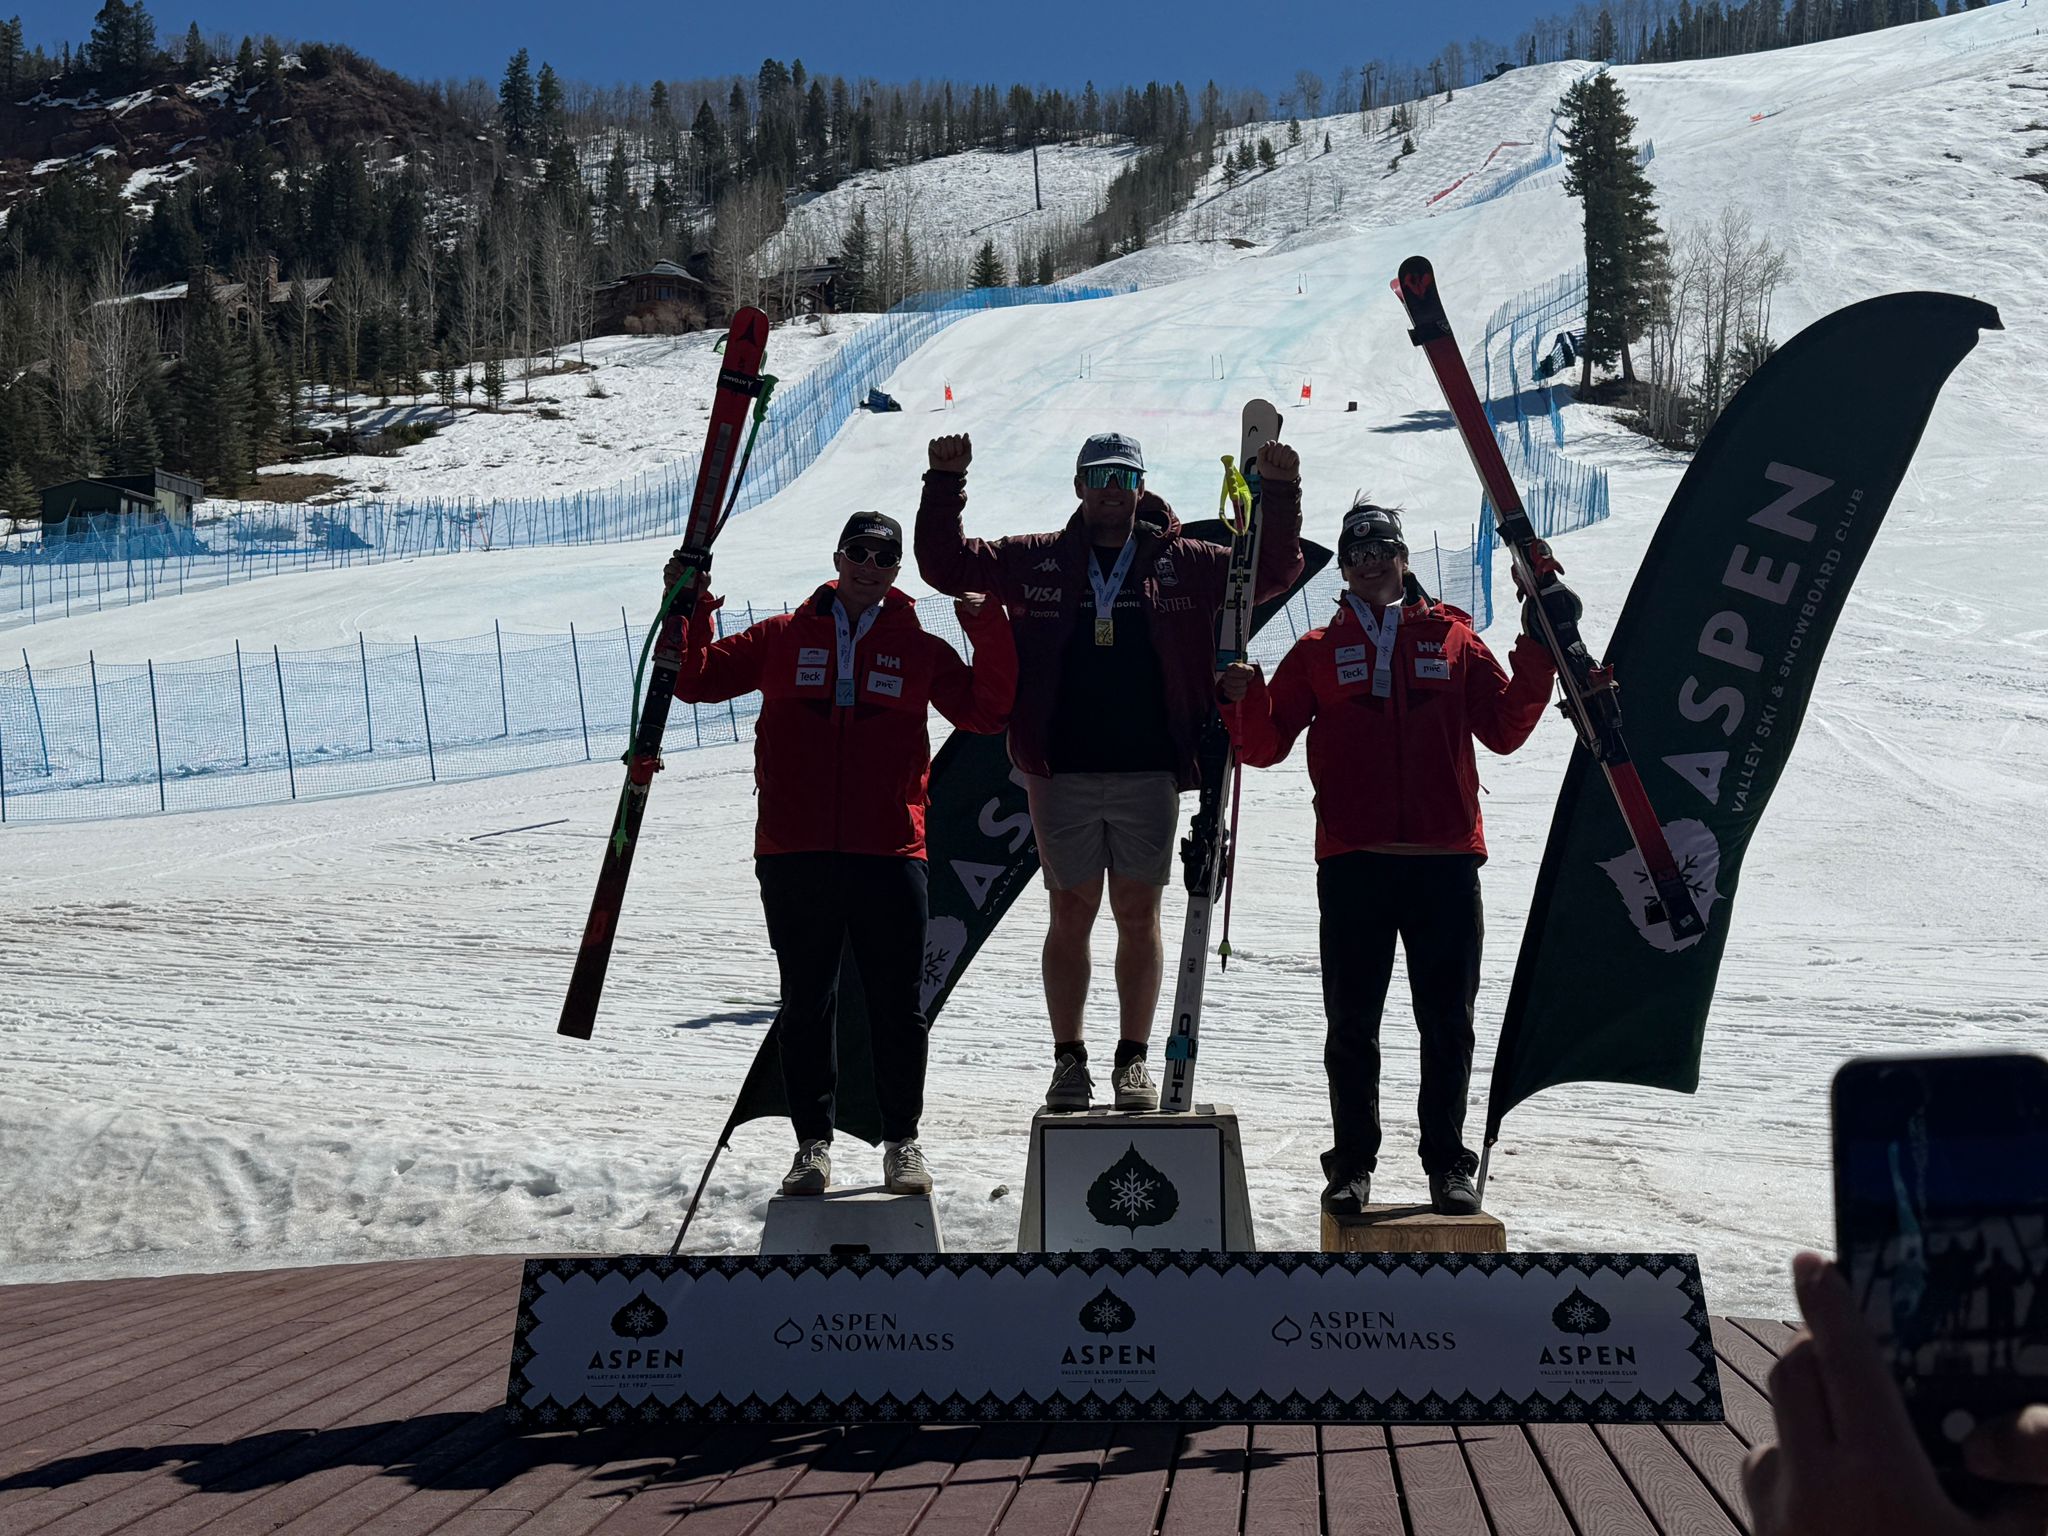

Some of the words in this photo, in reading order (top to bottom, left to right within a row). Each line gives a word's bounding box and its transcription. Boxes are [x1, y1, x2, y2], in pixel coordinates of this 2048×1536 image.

[1021, 584, 1062, 602] VISA
[1158, 596, 1197, 613] STIFEL
[1029, 609, 1060, 619] TOYOTA
[1661, 461, 1836, 806] ASPEN
[1731, 742, 1764, 813] VALLEY
[1757, 704, 1777, 738] SKI
[1771, 683, 1784, 698] &
[1780, 549, 1843, 679] SNOWBOARD
[1835, 488, 1864, 540] CLUB
[876, 653, 900, 670] HH
[800, 672, 820, 681] Teck
[1342, 667, 1364, 679] Teck
[875, 680, 894, 689] pwc
[1170, 1013, 1191, 1103] HED
[812, 1313, 897, 1331] ASPEN
[1309, 1311, 1395, 1329] ASPEN
[811, 1333, 954, 1352] SNOWMASS
[1309, 1332, 1456, 1350] SNOWMASS
[588, 1349, 683, 1369] ASPEN
[1061, 1345, 1155, 1365] ASPEN
[1539, 1346, 1636, 1365] ASPEN
